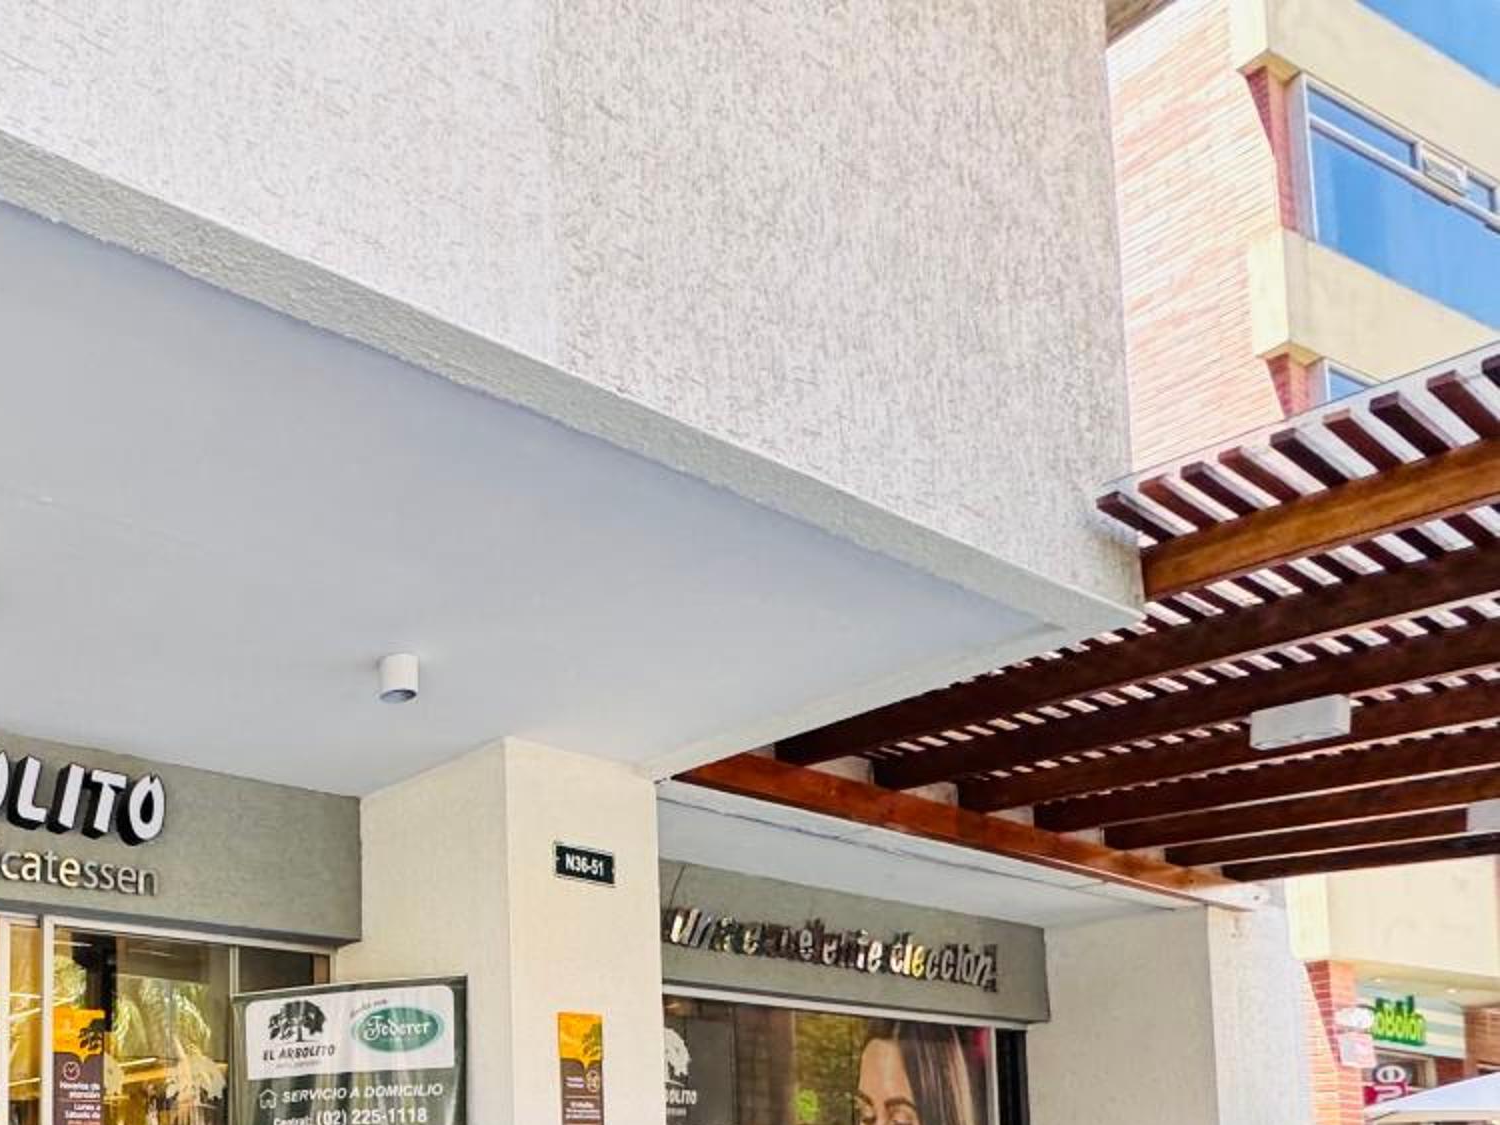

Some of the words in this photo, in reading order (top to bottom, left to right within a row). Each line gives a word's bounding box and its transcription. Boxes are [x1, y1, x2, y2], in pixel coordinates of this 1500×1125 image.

[565, 853, 604, 877] N36-51
[282, 1086, 347, 1103] SERVICIO
[350, 1086, 360, 1098] A
[364, 1083, 444, 1098] DOMICILIO
[351, 1107, 427, 1125] 225-1118
